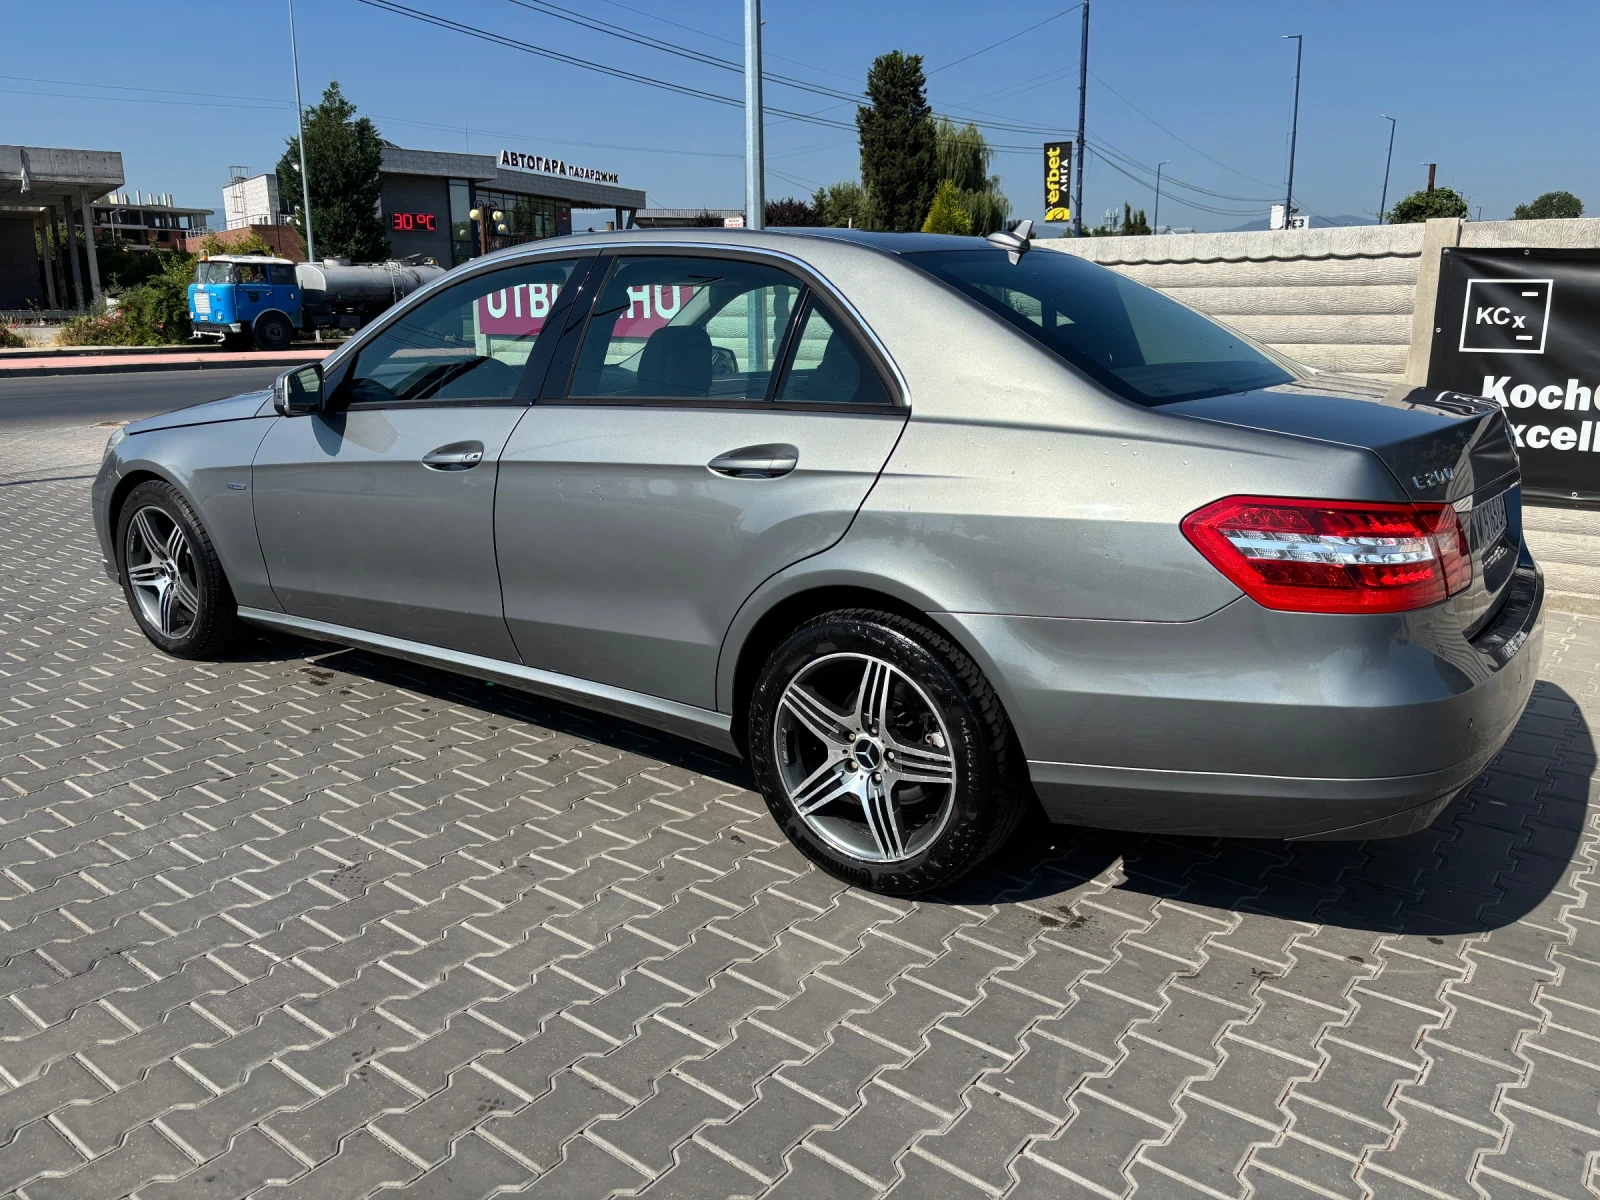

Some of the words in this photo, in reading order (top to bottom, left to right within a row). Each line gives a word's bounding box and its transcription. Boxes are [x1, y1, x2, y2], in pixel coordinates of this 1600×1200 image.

[500, 150, 566, 175] АВТОГАРА
[568, 165, 618, 184] ПАЗАРДЖИК
[1046, 147, 1060, 204] efbet
[394, 213, 412, 230] 30
[1482, 375, 1600, 411] Koch
[1510, 420, 1600, 452] xcell
